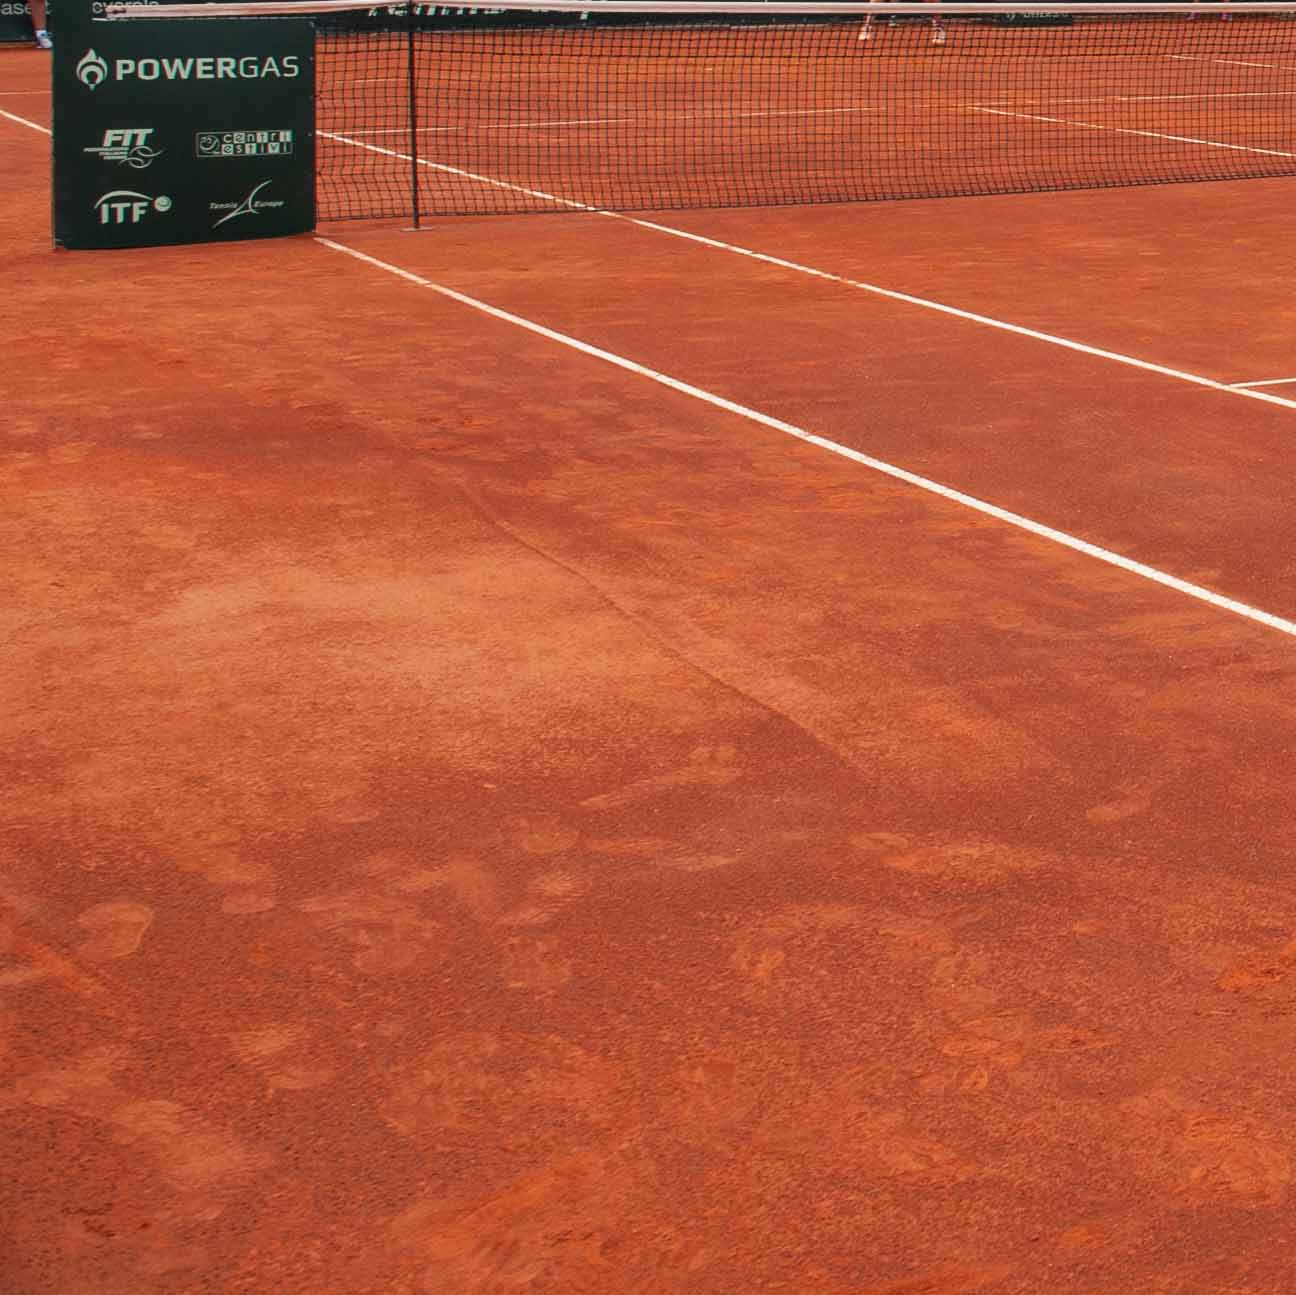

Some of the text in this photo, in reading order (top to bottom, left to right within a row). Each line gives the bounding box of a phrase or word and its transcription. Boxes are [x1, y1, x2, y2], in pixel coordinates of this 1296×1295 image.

[115, 55, 300, 81] POWERGAS
[102, 127, 155, 147] FIT
[99, 202, 150, 225] ITF
